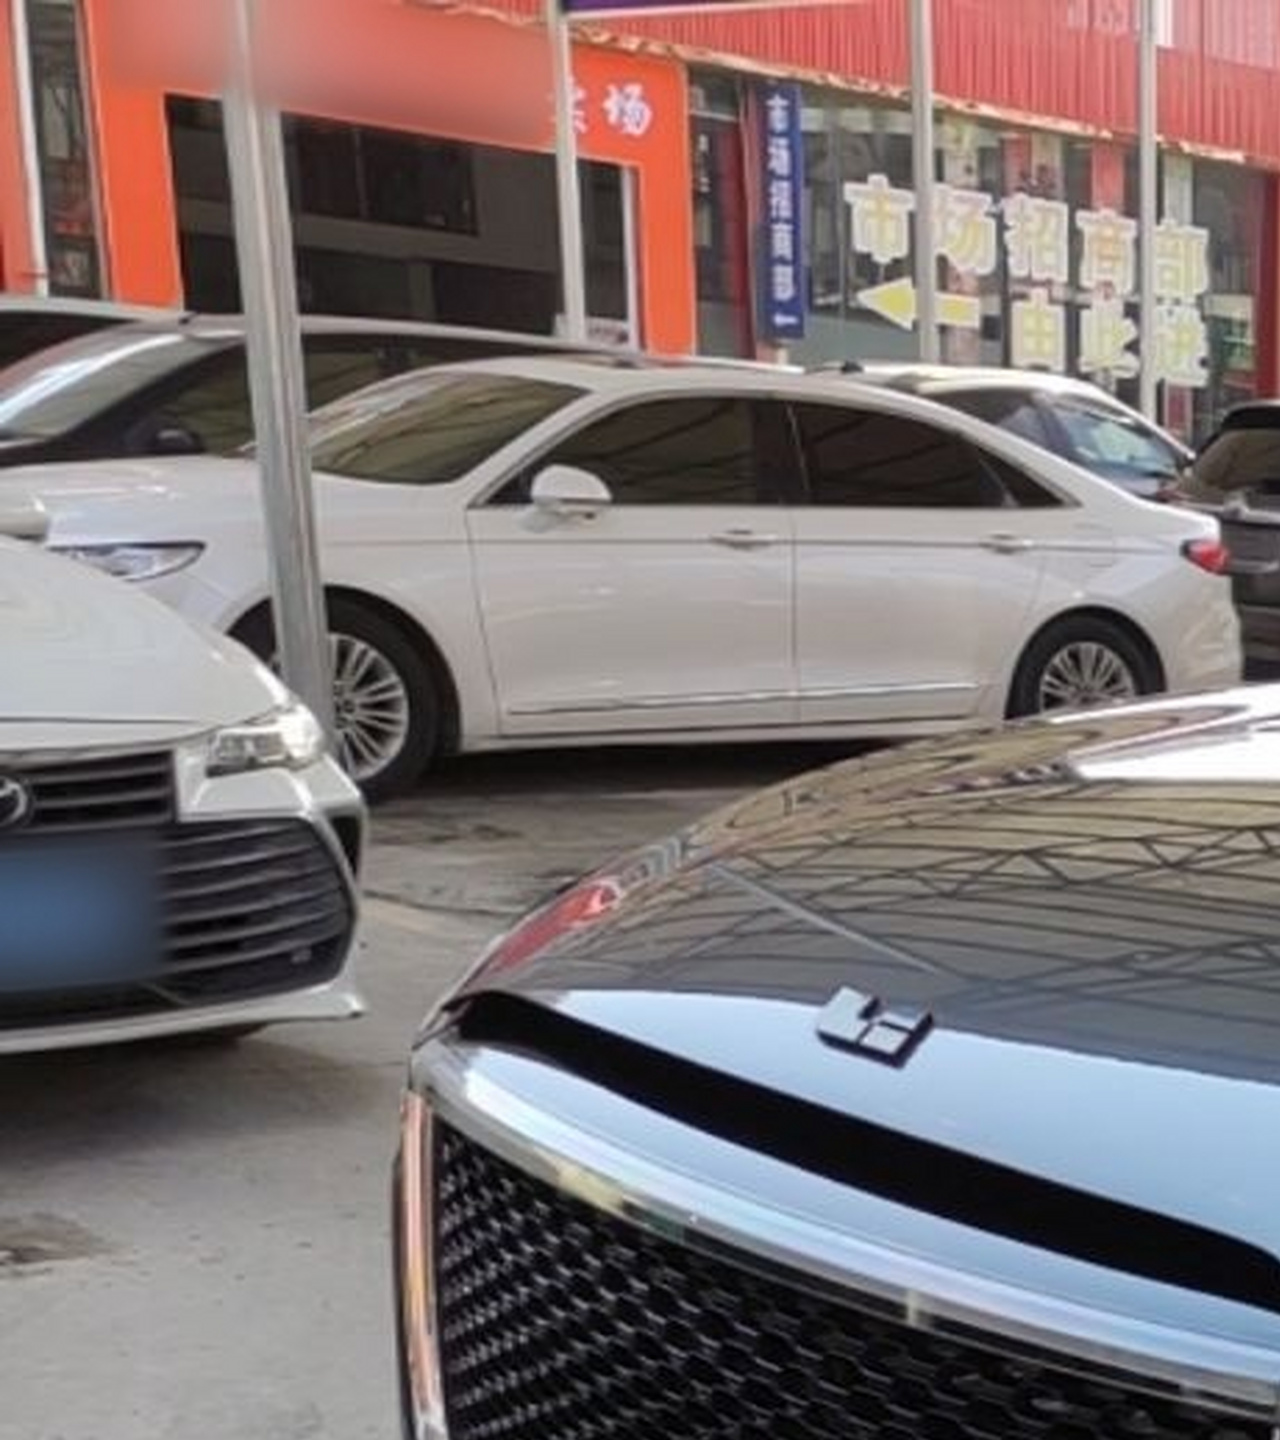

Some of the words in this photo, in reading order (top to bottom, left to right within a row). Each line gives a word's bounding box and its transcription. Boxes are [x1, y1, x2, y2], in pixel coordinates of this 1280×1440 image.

[844, 174, 1209, 299] 市场招商部
